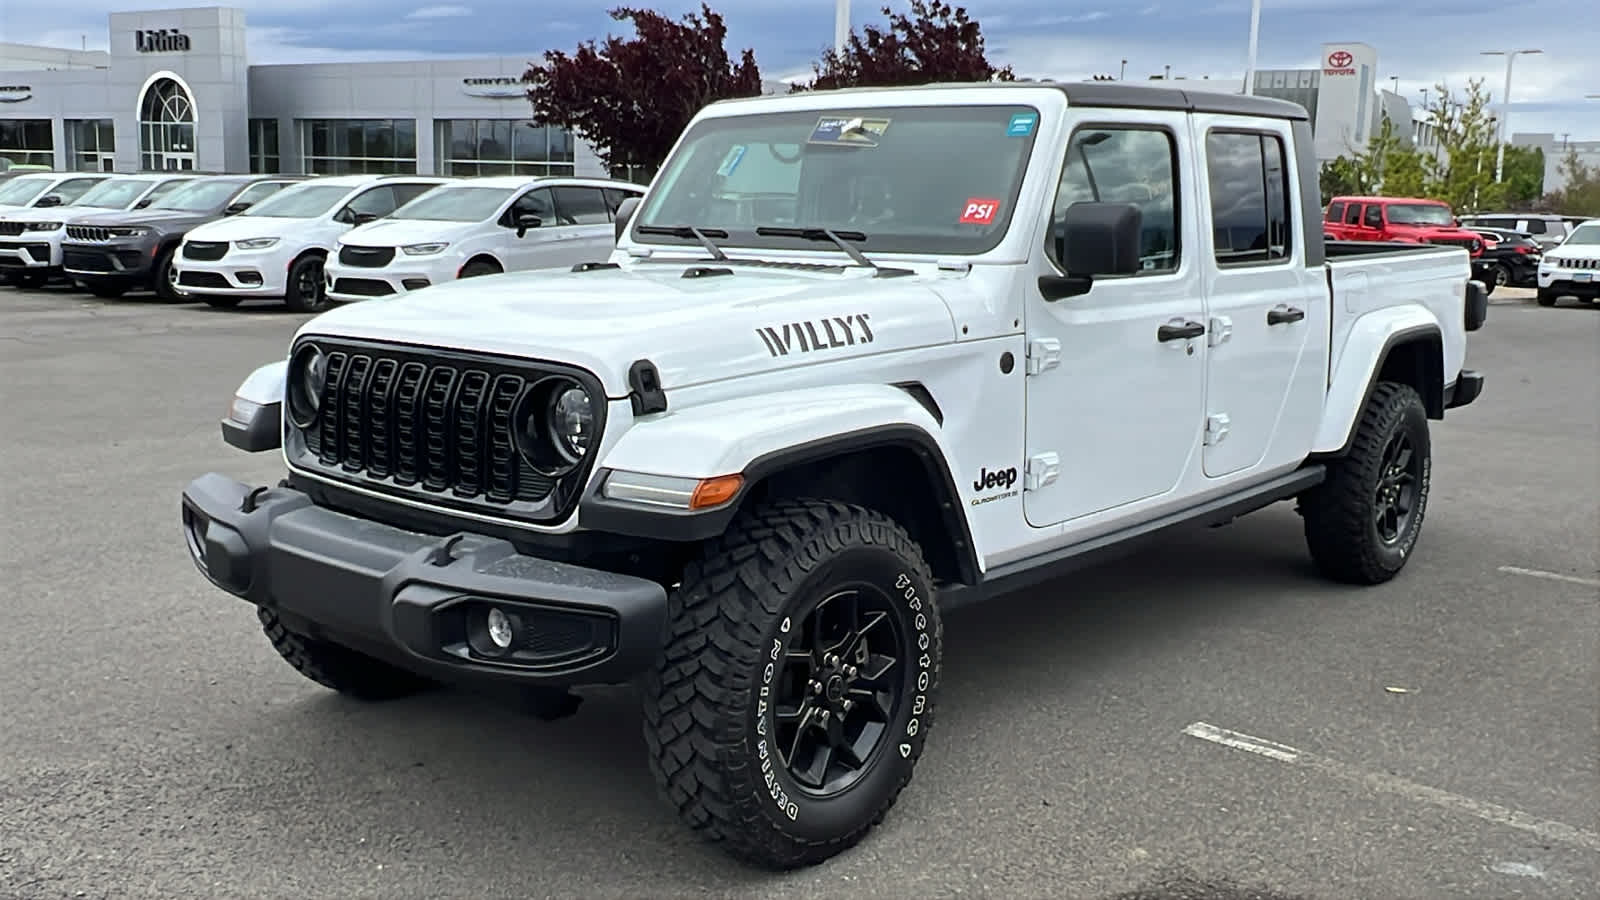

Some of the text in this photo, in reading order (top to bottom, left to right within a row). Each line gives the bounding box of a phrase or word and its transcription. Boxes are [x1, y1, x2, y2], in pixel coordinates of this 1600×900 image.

[136, 29, 191, 53] Lithia
[964, 203, 993, 219] PSI
[755, 314, 873, 357] WILLYS
[973, 467, 1017, 491] Jeep
[757, 638, 799, 821] DESTINATION
